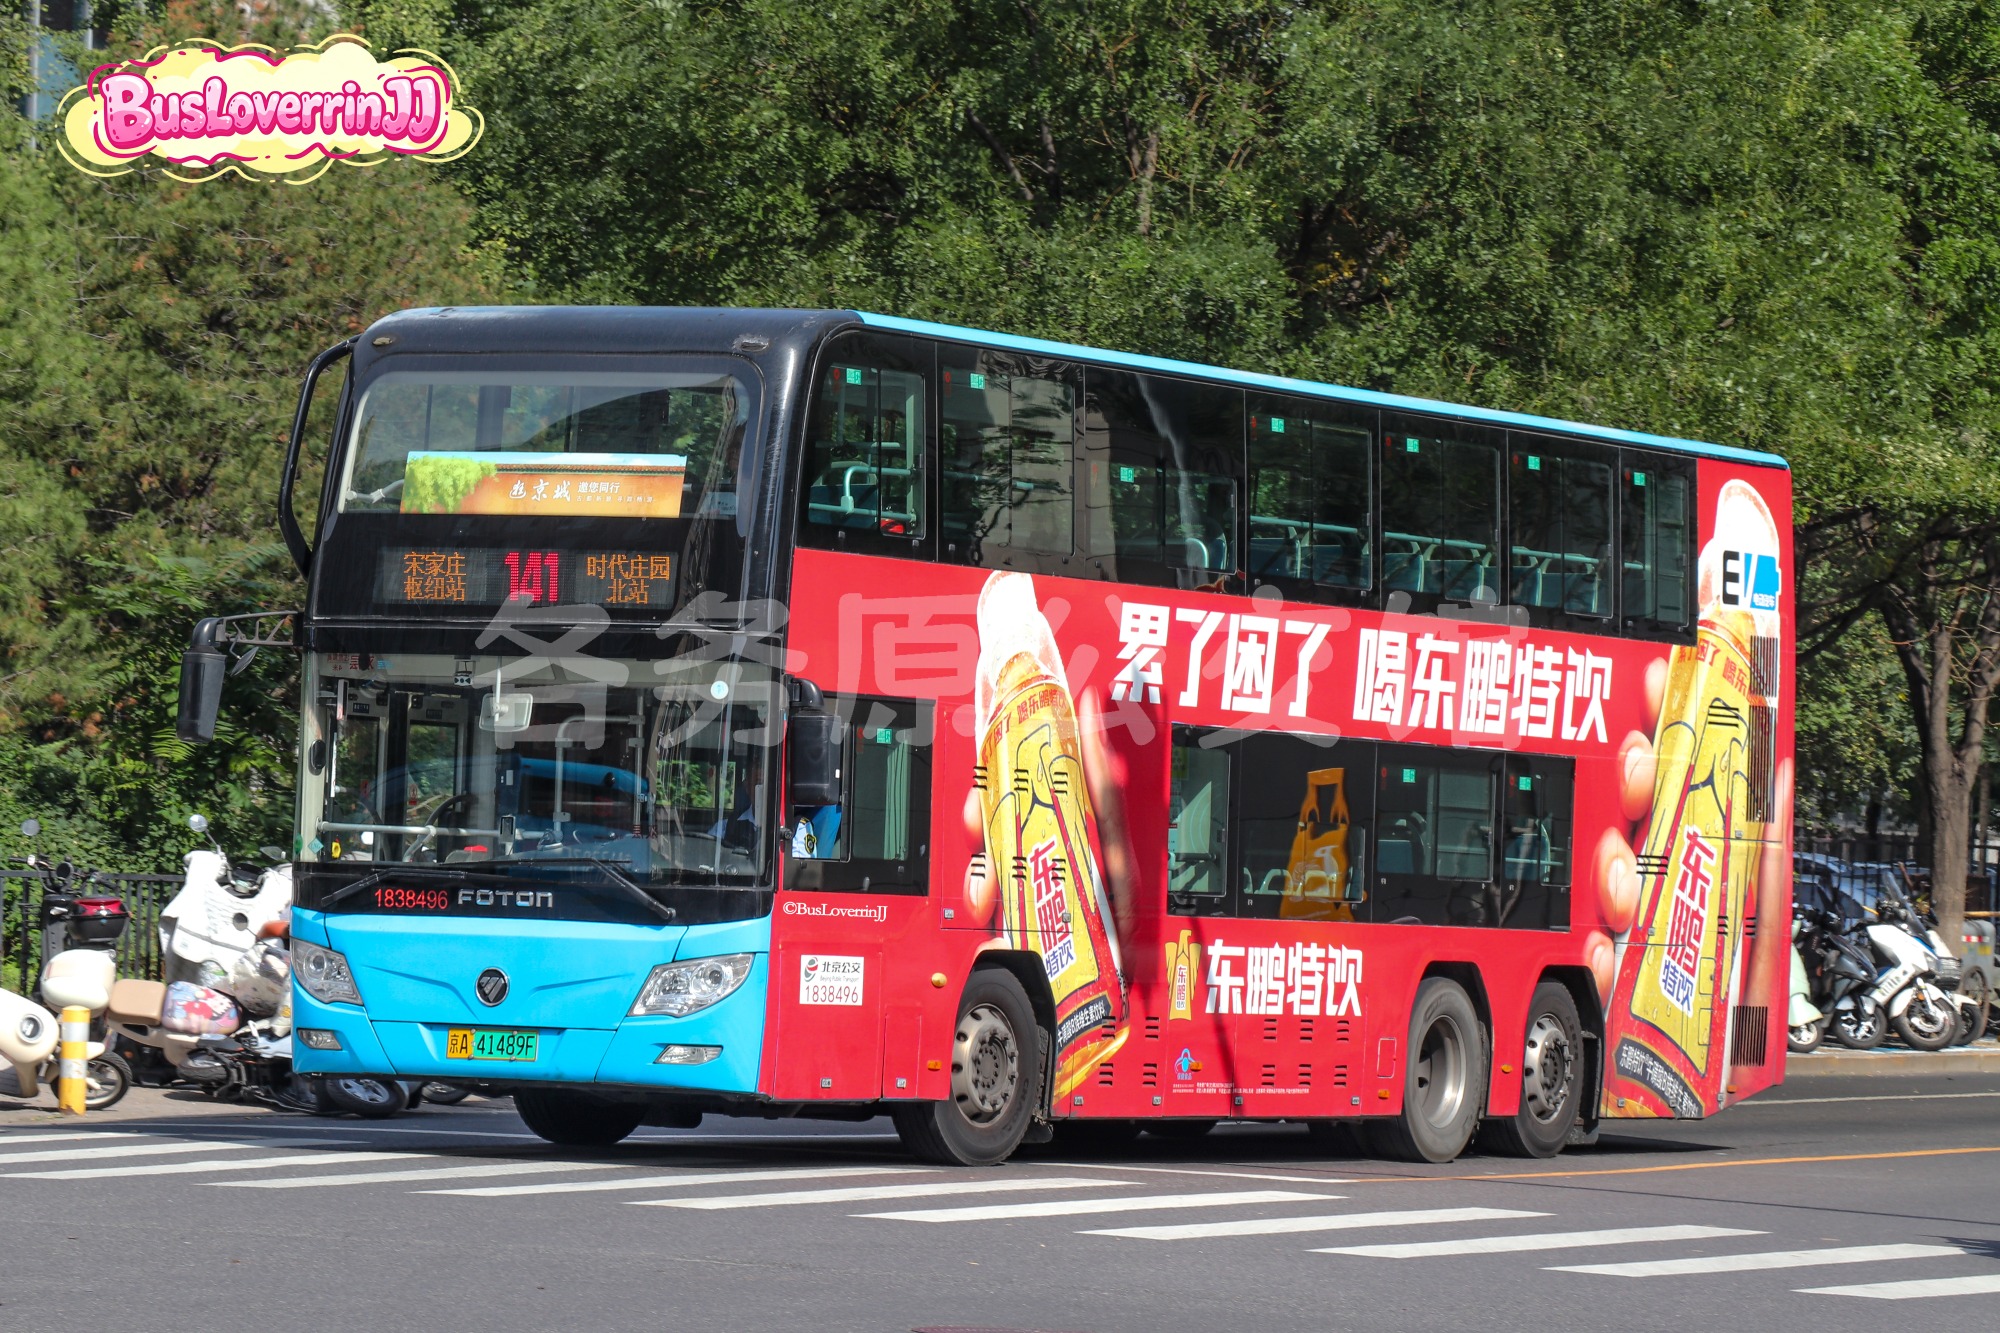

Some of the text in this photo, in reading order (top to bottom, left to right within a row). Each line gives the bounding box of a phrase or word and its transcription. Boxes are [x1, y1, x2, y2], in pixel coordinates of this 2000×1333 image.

[577, 481, 620, 494] 邀您同行
[403, 551, 467, 577] 宋家庄
[586, 554, 670, 580] 时代庄园
[403, 576, 466, 601] 枢纽站
[504, 552, 559, 602] 141
[606, 579, 649, 604] 北站
[1111, 602, 1613, 743] 累了困了 喝东鹏特饮
[374, 888, 448, 910] 1838496
[458, 888, 553, 908] FOTON
[821, 961, 861, 974] 北京公交
[1205, 939, 1363, 1017] 东鹏特饮
[805, 985, 859, 1004] 1838496
